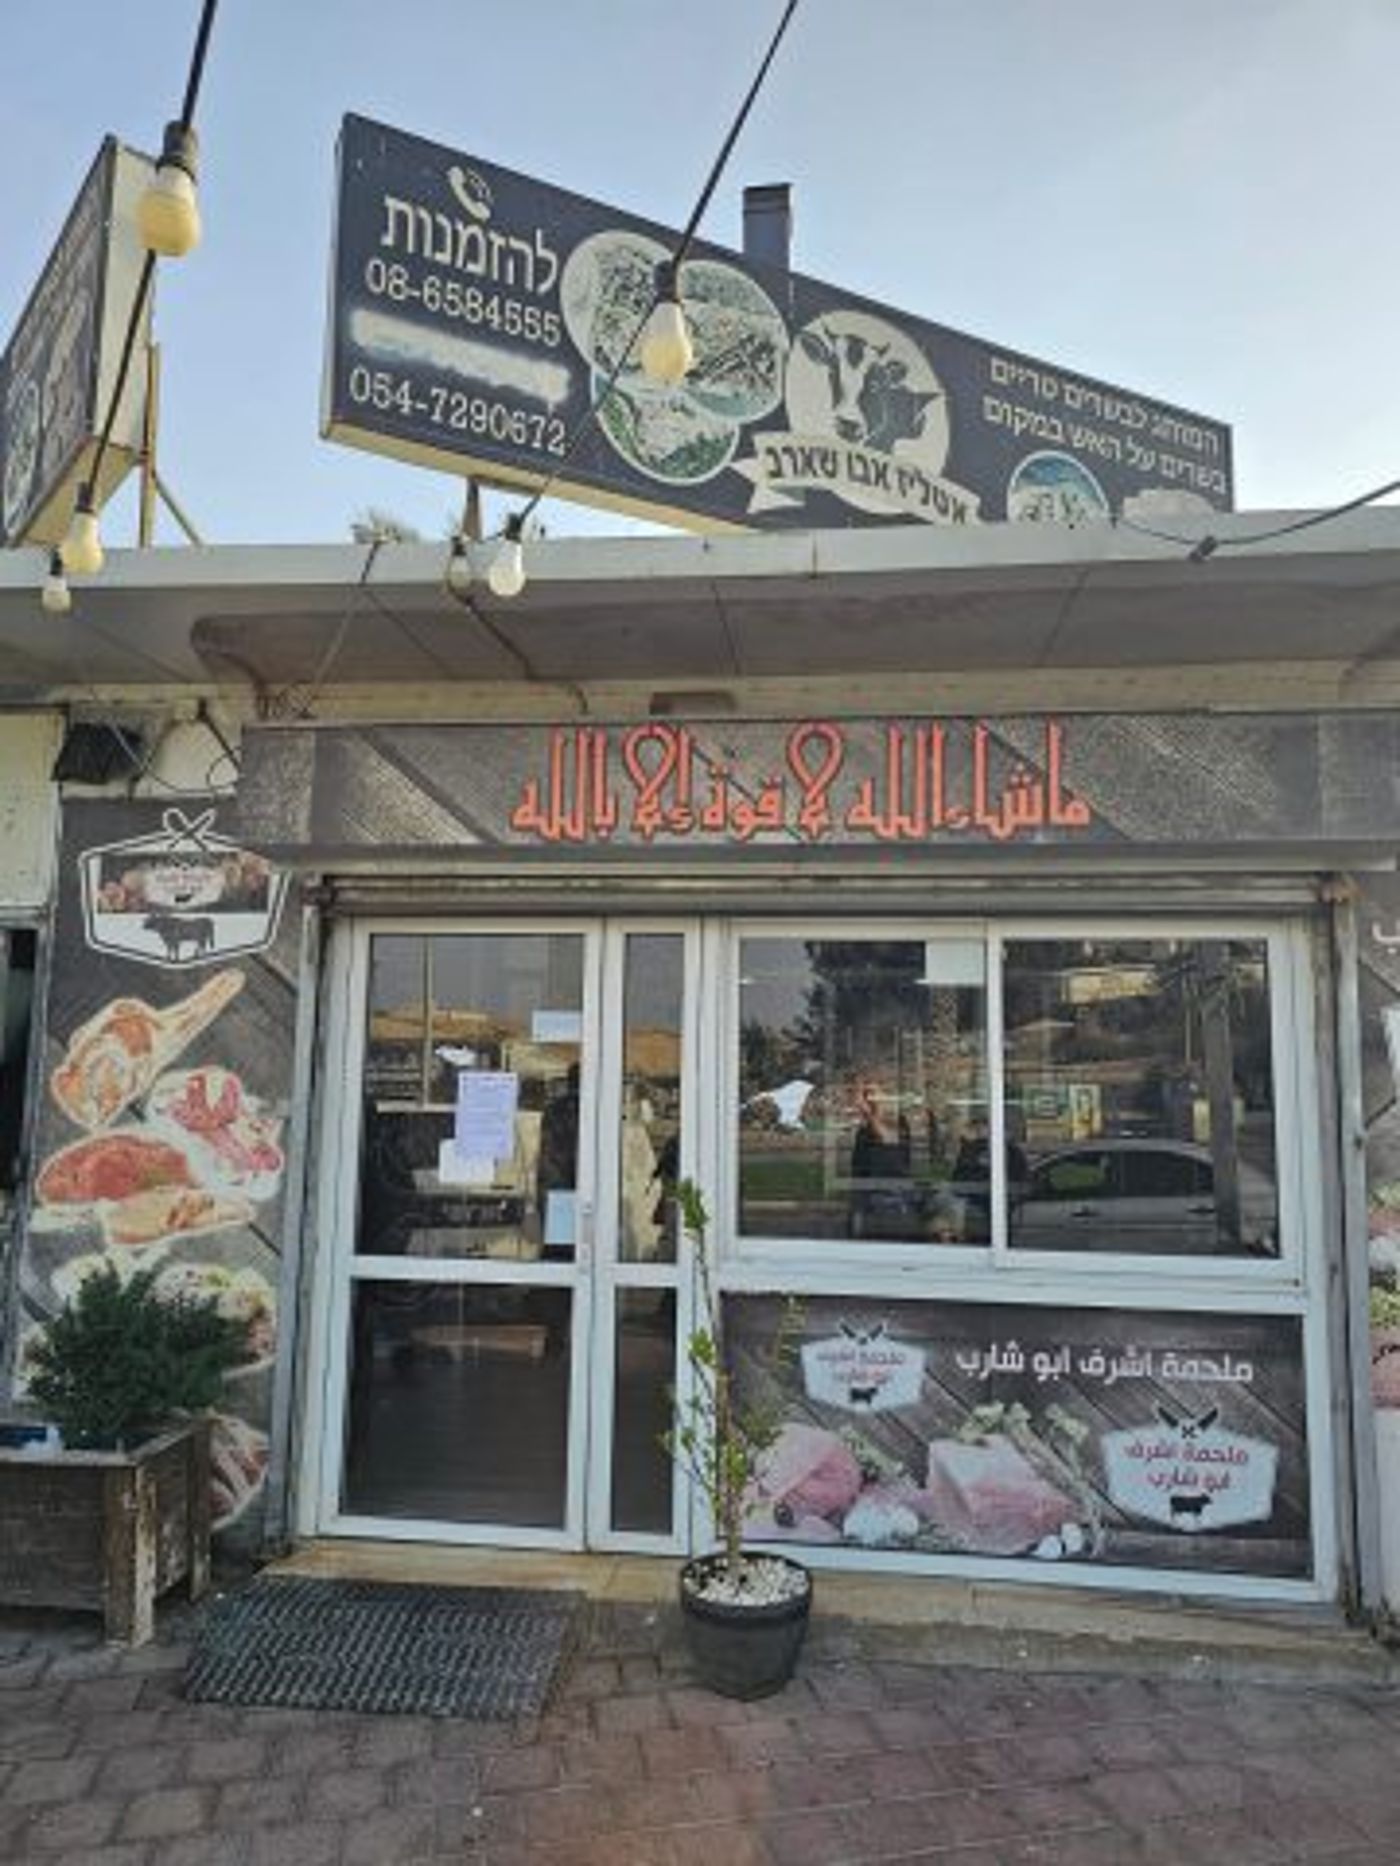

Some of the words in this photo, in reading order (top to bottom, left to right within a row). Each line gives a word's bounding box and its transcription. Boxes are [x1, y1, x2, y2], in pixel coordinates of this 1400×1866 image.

[381, 195, 558, 294] להזמנות
[366, 258, 561, 347] 08-6584555
[982, 395, 1065, 444] במקום
[766, 446, 838, 479] שארב
[847, 450, 891, 491] אבו
[1126, 434, 1157, 471] על
[1158, 452, 1227, 494] בשרים
[898, 466, 967, 525] אטליז
[510, 724, 618, 842] بالله
[1048, 719, 1091, 826] ما
[956, 1340, 1024, 1381] شارب
[1033, 1345, 1071, 1382] ابو
[1080, 1344, 1152, 1385] اشرف
[1162, 1352, 1253, 1382] ملحمة
